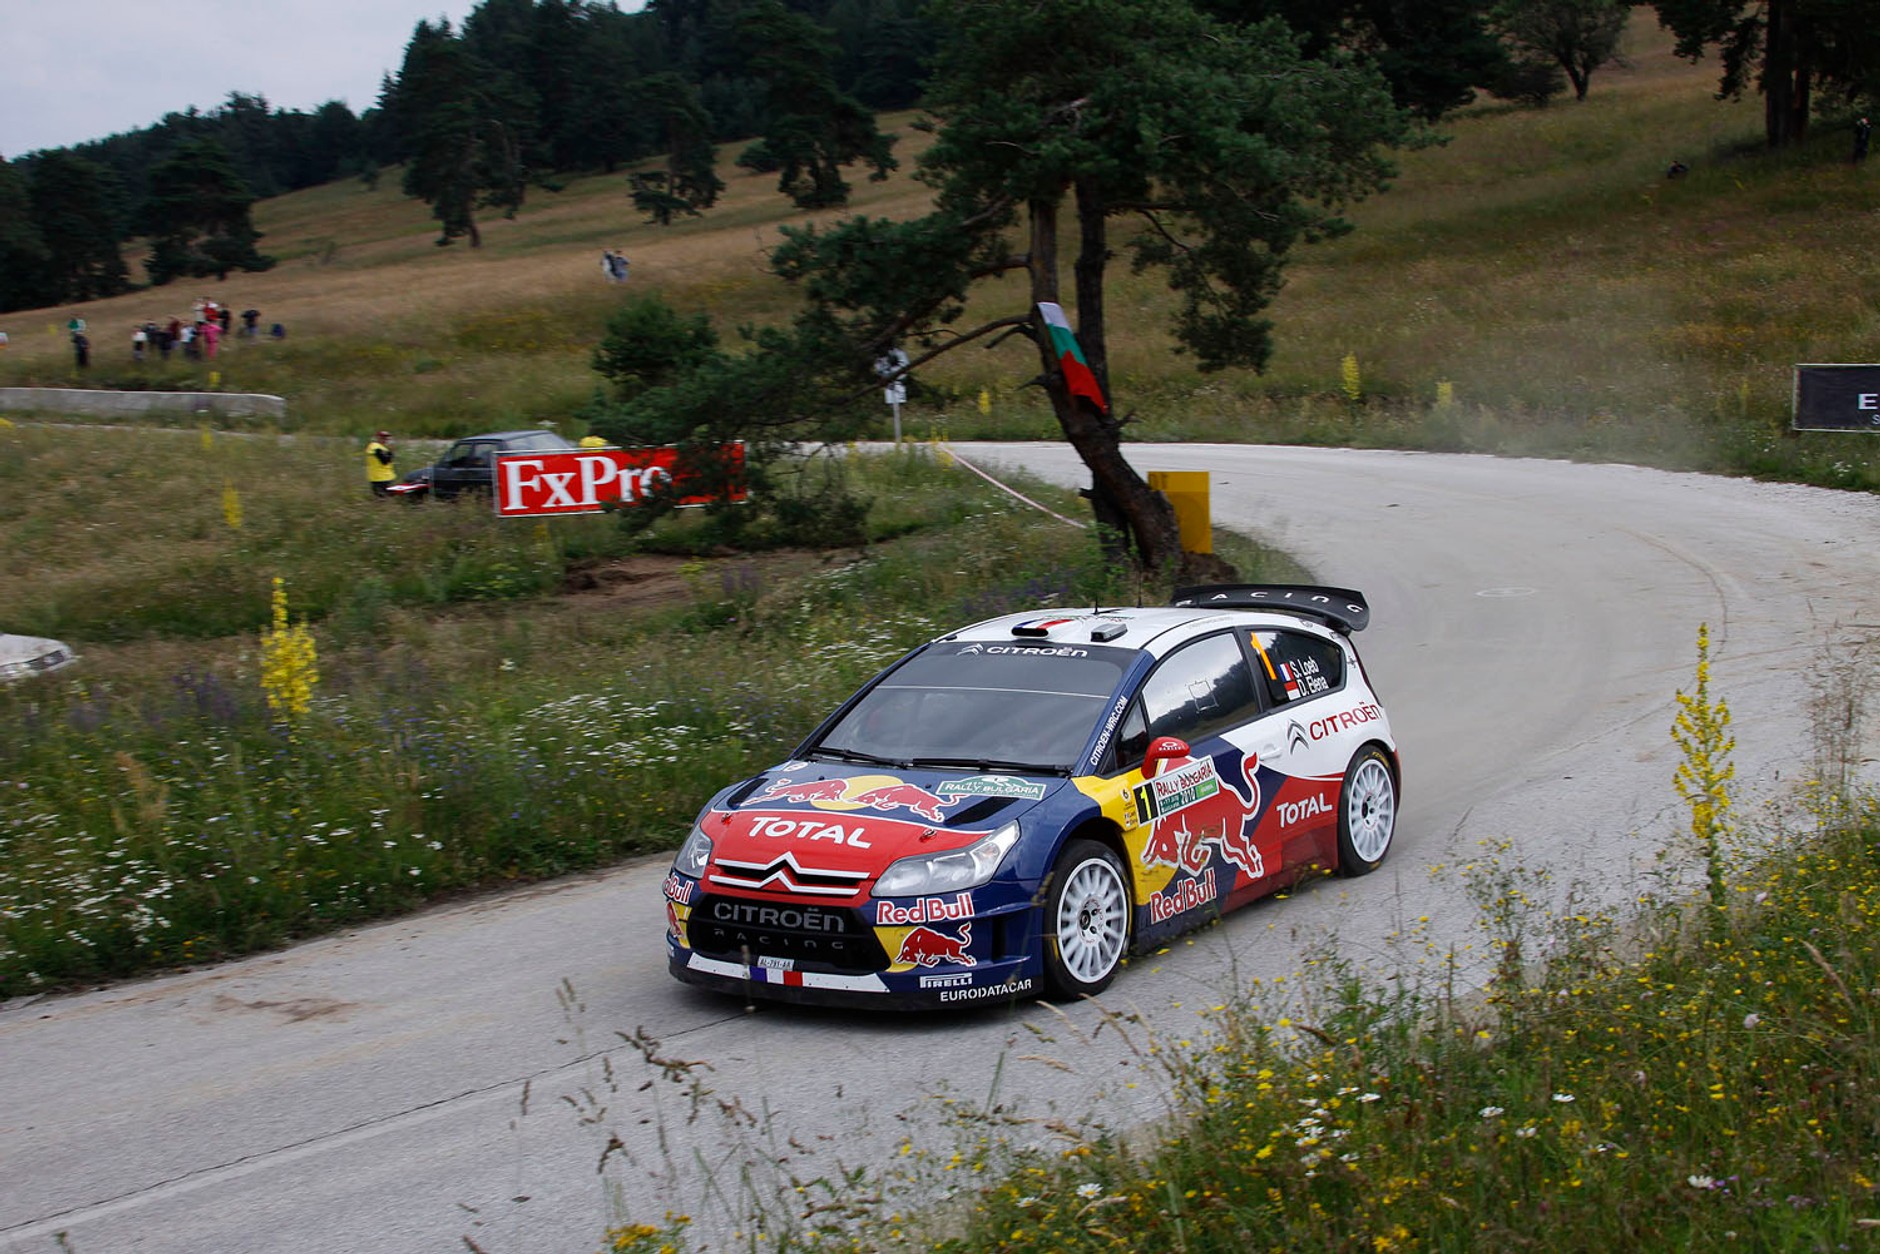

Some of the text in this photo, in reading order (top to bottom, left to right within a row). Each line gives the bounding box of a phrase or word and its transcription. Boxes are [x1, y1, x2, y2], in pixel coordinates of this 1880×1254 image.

[500, 455, 673, 511] FxPro
[1250, 631, 1277, 680] 1
[1289, 655, 1320, 679] S. Loeb
[1296, 675, 1330, 697] D. Elena
[944, 783, 981, 793] RALLY
[982, 785, 1039, 795] BULGARIA
[1155, 761, 1214, 797] RALLY BULGARIA
[1140, 785, 1152, 820] 1
[1276, 793, 1332, 828] TOTAL
[749, 816, 872, 849] TOTAL
[877, 892, 975, 924] Red Bull
[1150, 867, 1216, 924] Red Bull
[919, 972, 973, 988] PIRELLI
[940, 979, 1033, 1002] EURODATACAR
